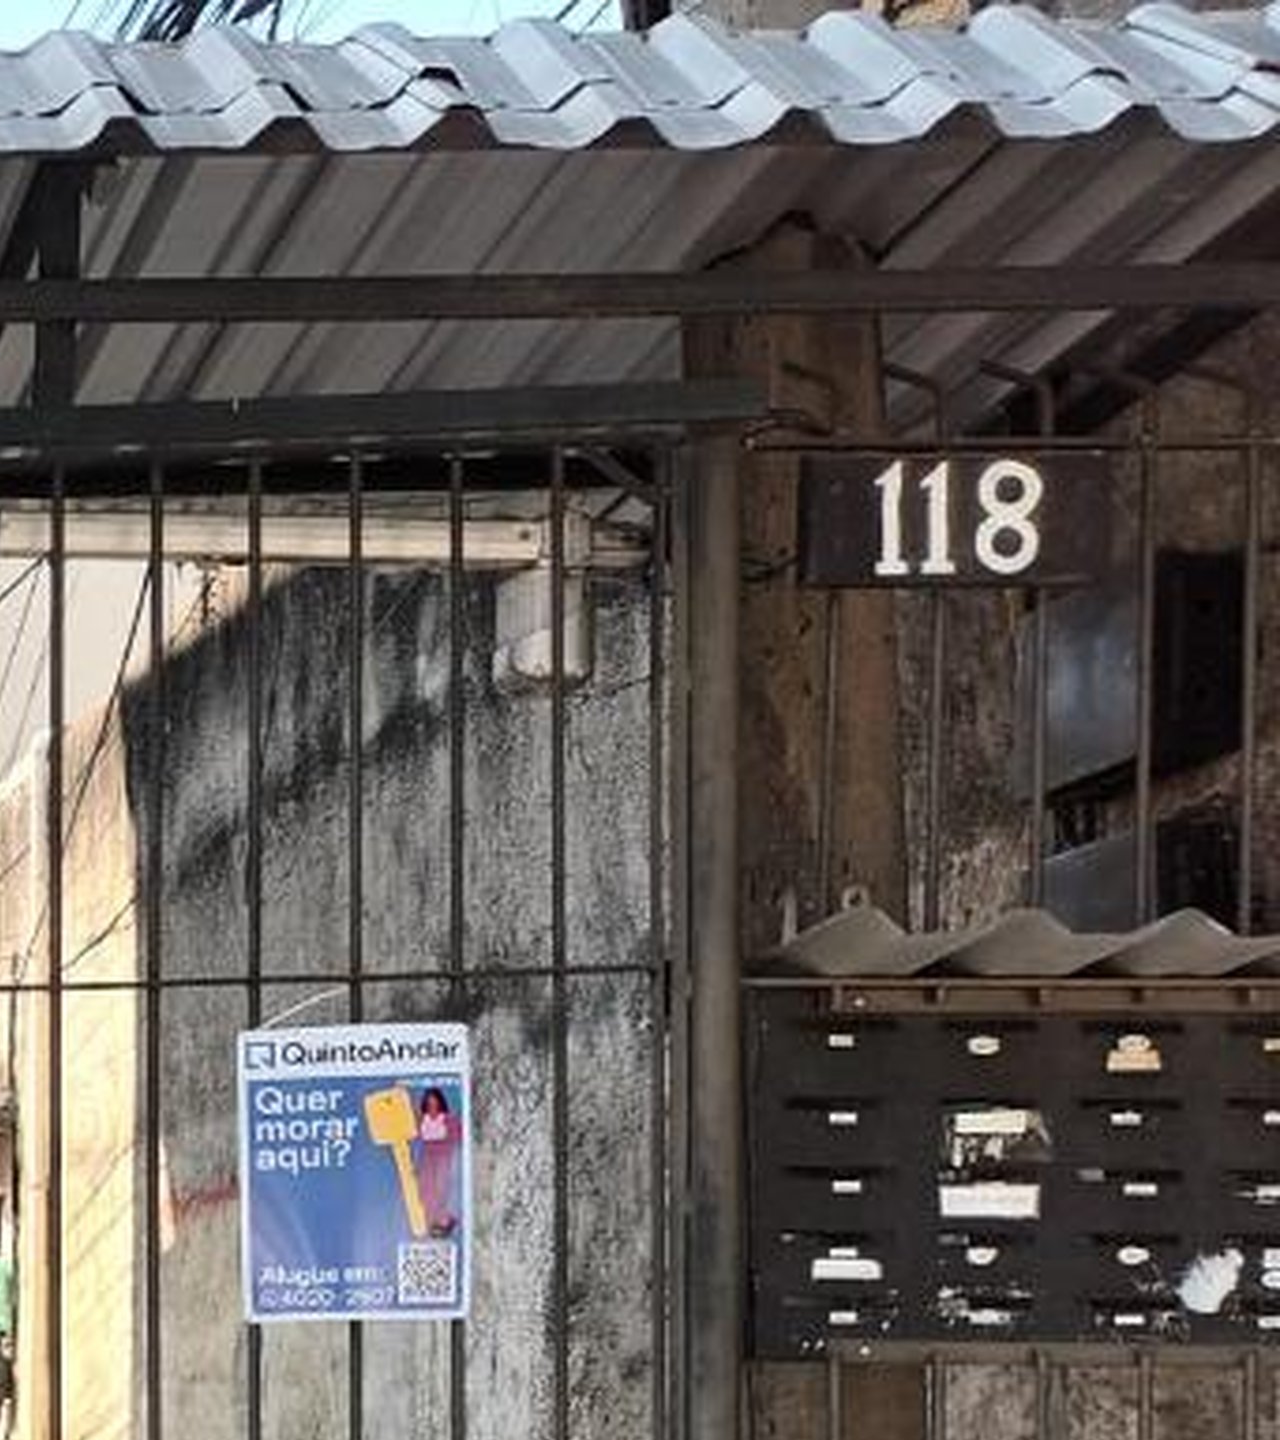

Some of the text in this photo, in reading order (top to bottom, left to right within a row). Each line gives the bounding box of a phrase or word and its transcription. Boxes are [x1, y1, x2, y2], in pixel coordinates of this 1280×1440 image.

[874, 460, 1042, 576] 118
[281, 1038, 460, 1066] QuintoAndar
[255, 1086, 344, 1115] Quer
[255, 1116, 359, 1141] morar
[255, 1139, 352, 1176] aqui?
[259, 1264, 339, 1287] Alugue
